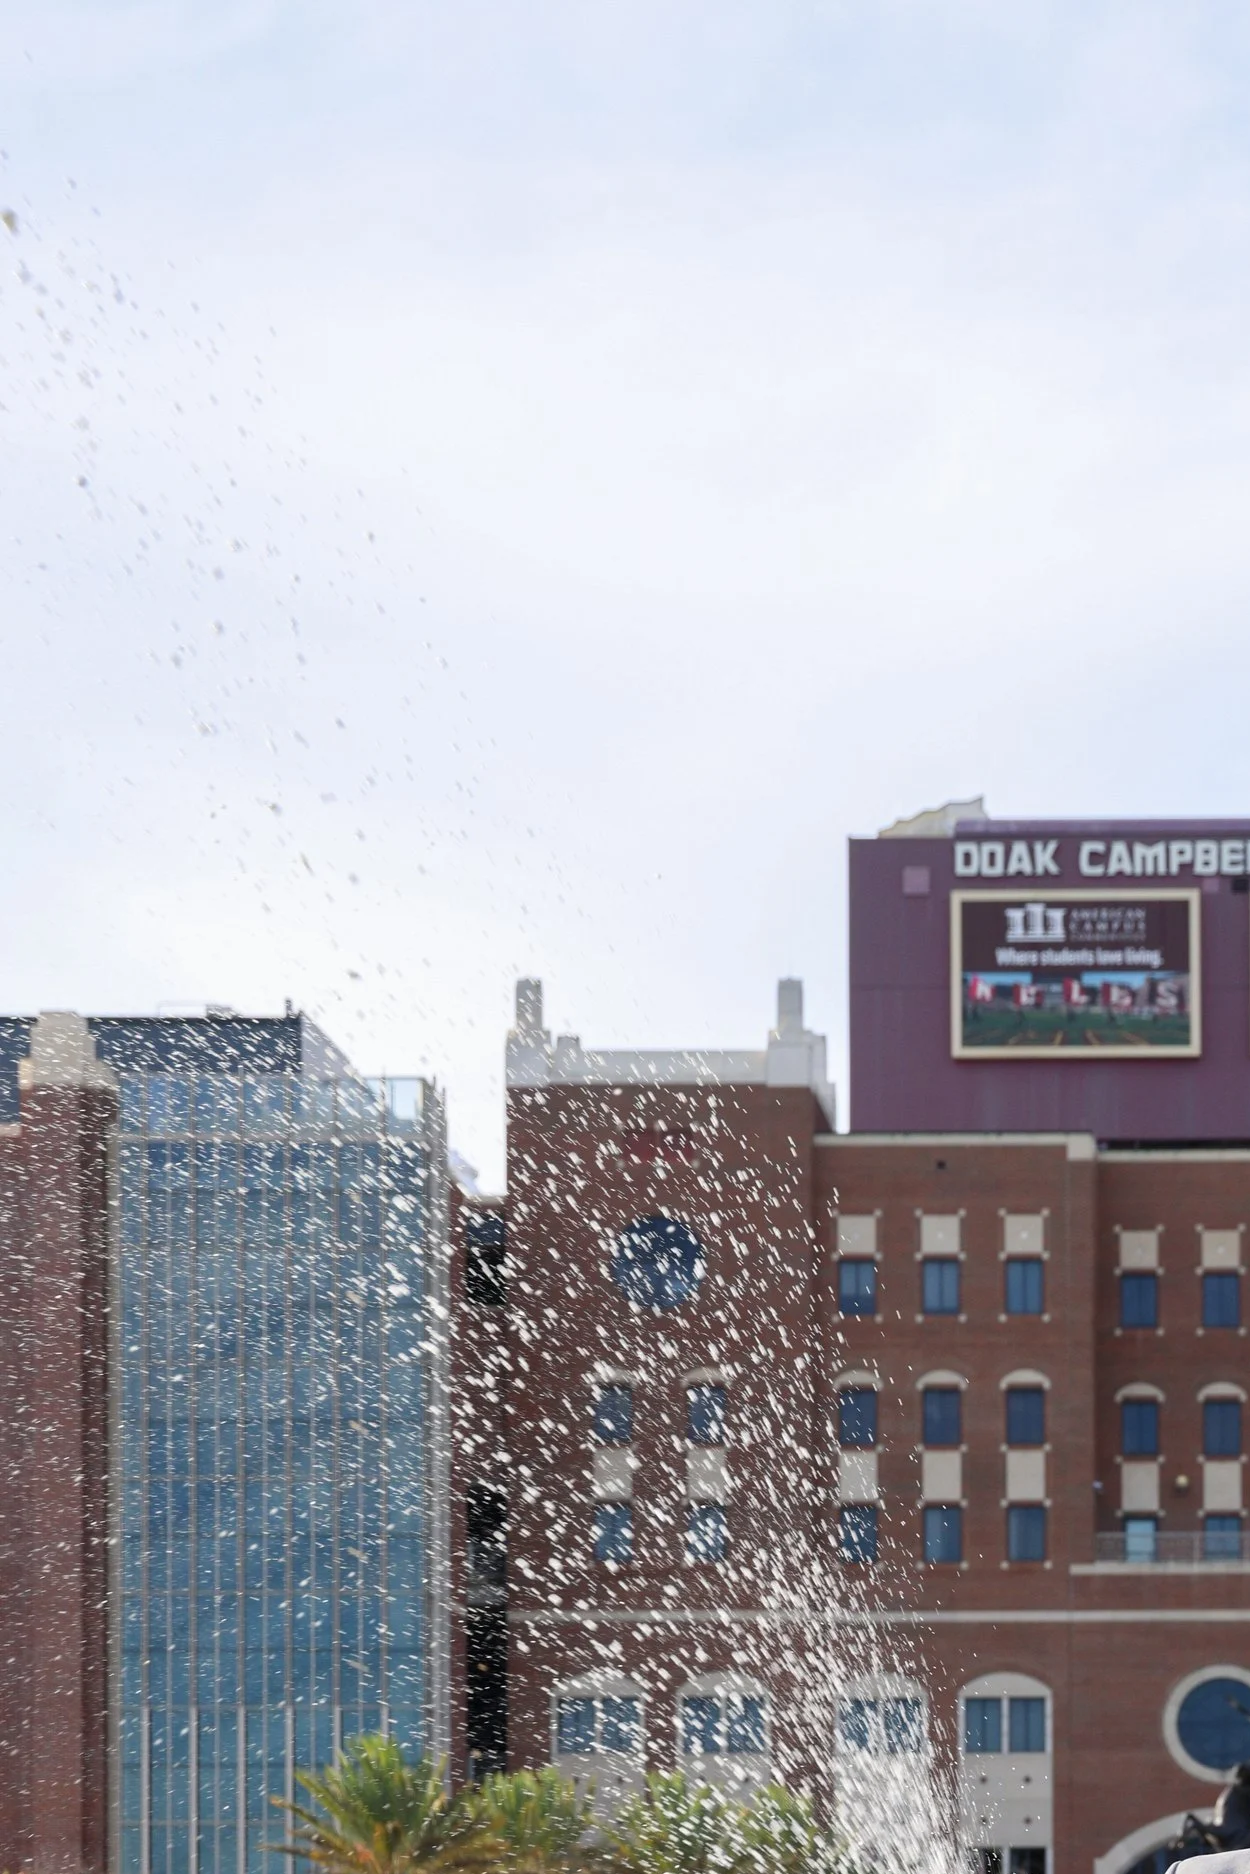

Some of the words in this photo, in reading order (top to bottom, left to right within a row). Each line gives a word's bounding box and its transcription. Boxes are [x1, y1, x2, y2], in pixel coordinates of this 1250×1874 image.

[954, 840, 1061, 877] DOAK
[1070, 907, 1147, 920] AMERICAN
[995, 946, 1038, 966] Where
[1040, 946, 1095, 966] students
[1096, 946, 1124, 966] love
